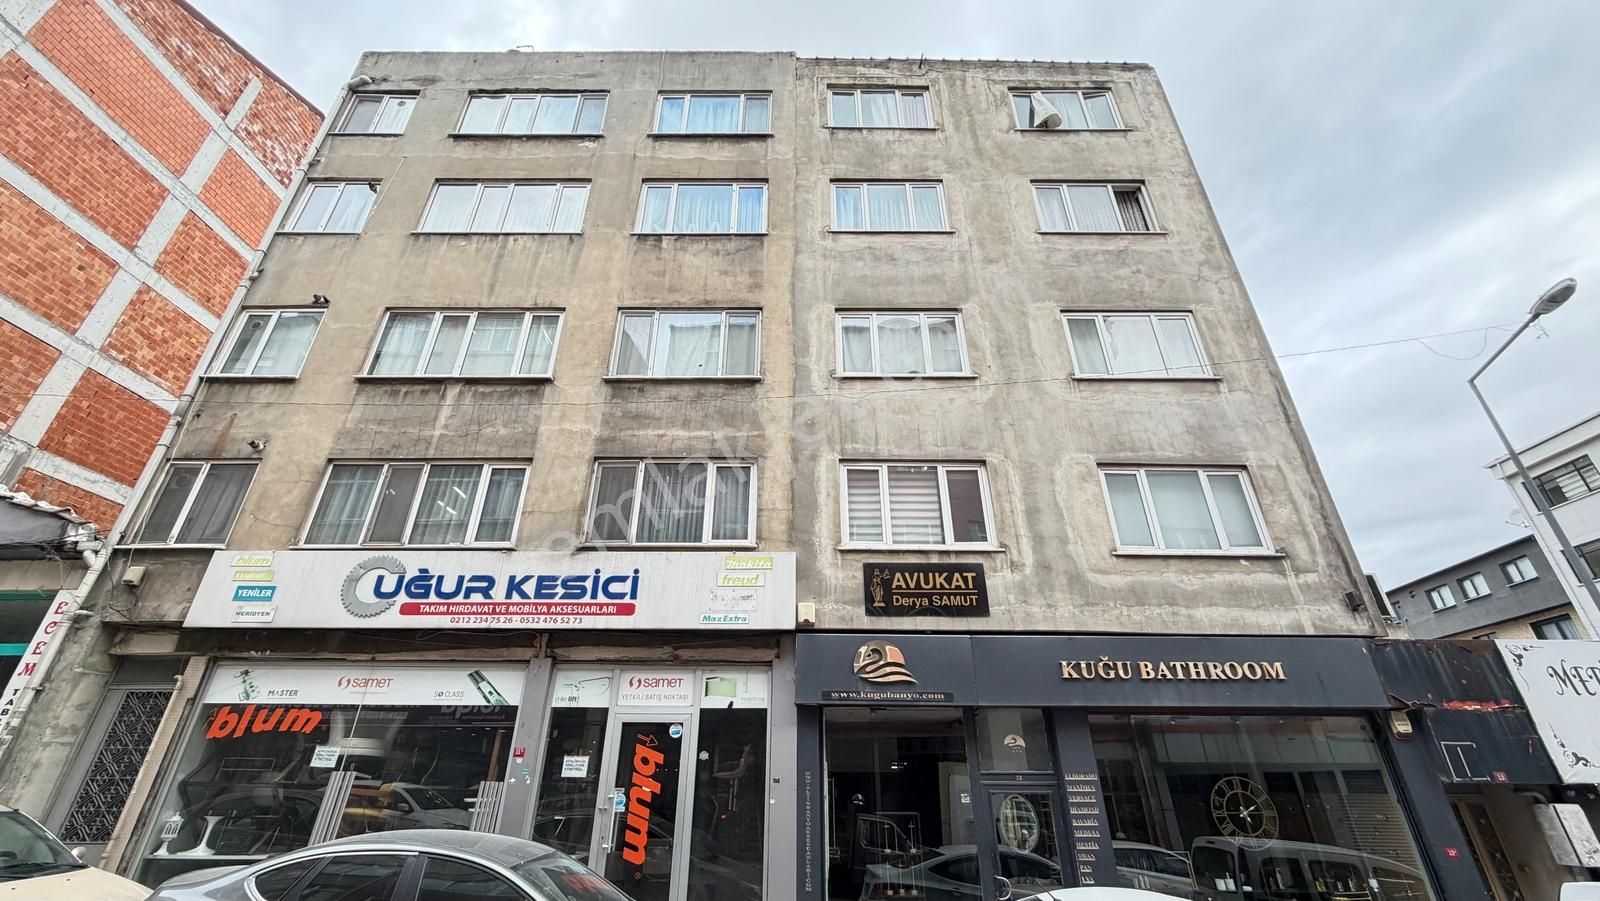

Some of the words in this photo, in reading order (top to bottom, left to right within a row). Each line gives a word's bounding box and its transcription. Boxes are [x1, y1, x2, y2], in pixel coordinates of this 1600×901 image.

[373, 568, 496, 600] UĞUR
[505, 568, 640, 600] KESİCİ
[722, 574, 760, 585] freud
[891, 572, 977, 589] AVUKAT
[238, 587, 273, 597] YENİLER
[892, 595, 929, 608] Derya
[932, 595, 979, 606] SAMUT
[419, 604, 447, 614] TAKIM
[449, 604, 493, 614] HIRDAVAT
[496, 604, 506, 614] VE
[508, 604, 547, 614] MOBİLYA
[550, 604, 617, 614] AKSESUARLARI
[450, 616, 471, 624] 0212
[473, 616, 489, 624] 234
[490, 616, 501, 624] 75
[503, 616, 514, 624] 26
[520, 616, 540, 624] 0532
[542, 616, 559, 624] 476
[560, 616, 571, 624] 52
[573, 616, 583, 624] 73
[1059, 656, 1132, 679] KUĞU
[1137, 661, 1287, 680] BATHROOM
[831, 691, 945, 700] www.kugubanyo.com
[205, 704, 323, 739] blum
[622, 743, 665, 865] blum
